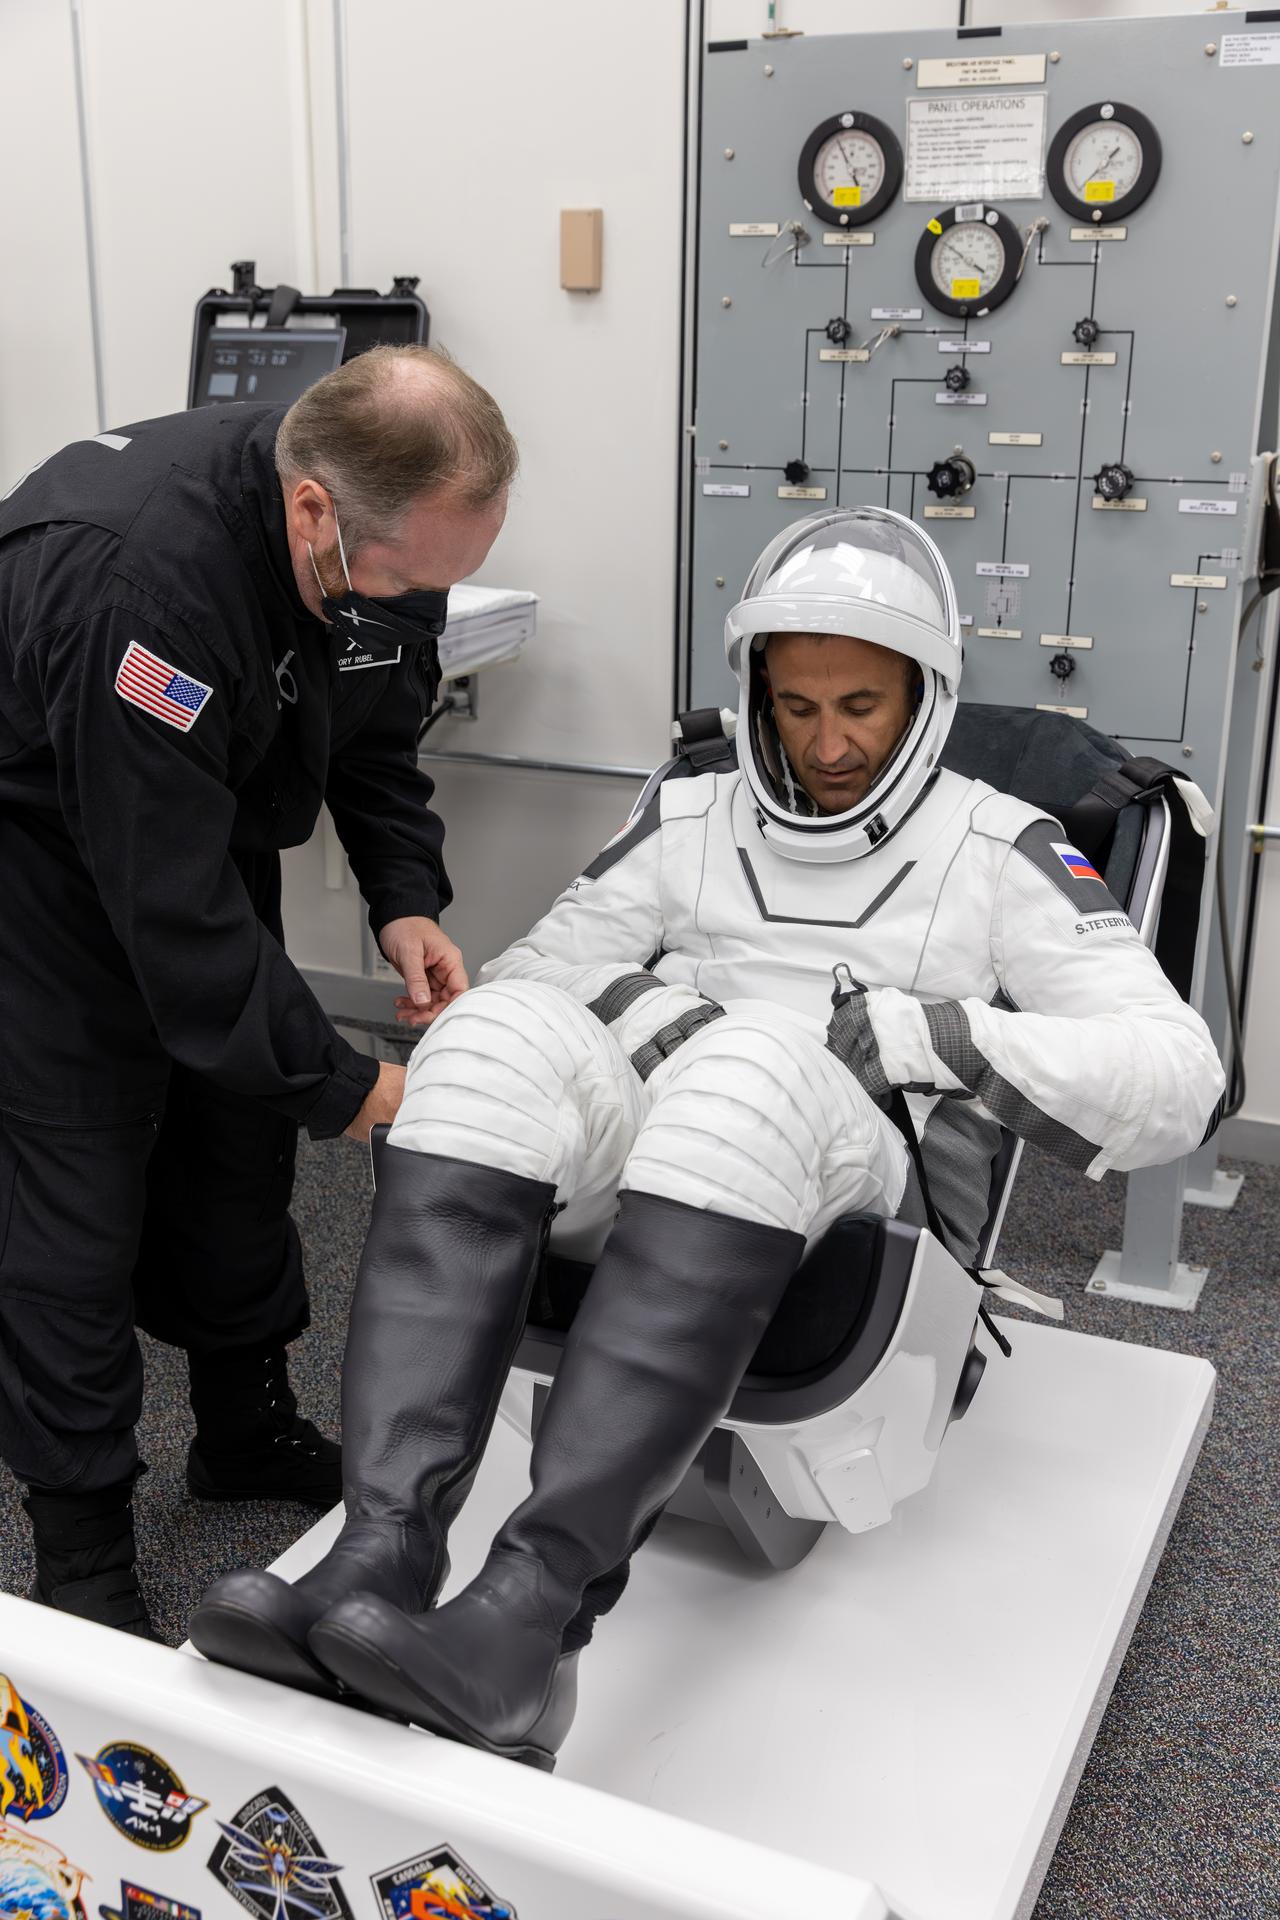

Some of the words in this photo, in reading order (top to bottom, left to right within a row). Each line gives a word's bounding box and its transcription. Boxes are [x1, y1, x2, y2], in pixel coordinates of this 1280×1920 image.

[928, 101, 959, 113] PANEL
[961, 98, 1026, 112] OPERATIONS
[354, 653, 374, 664] RUBEL
